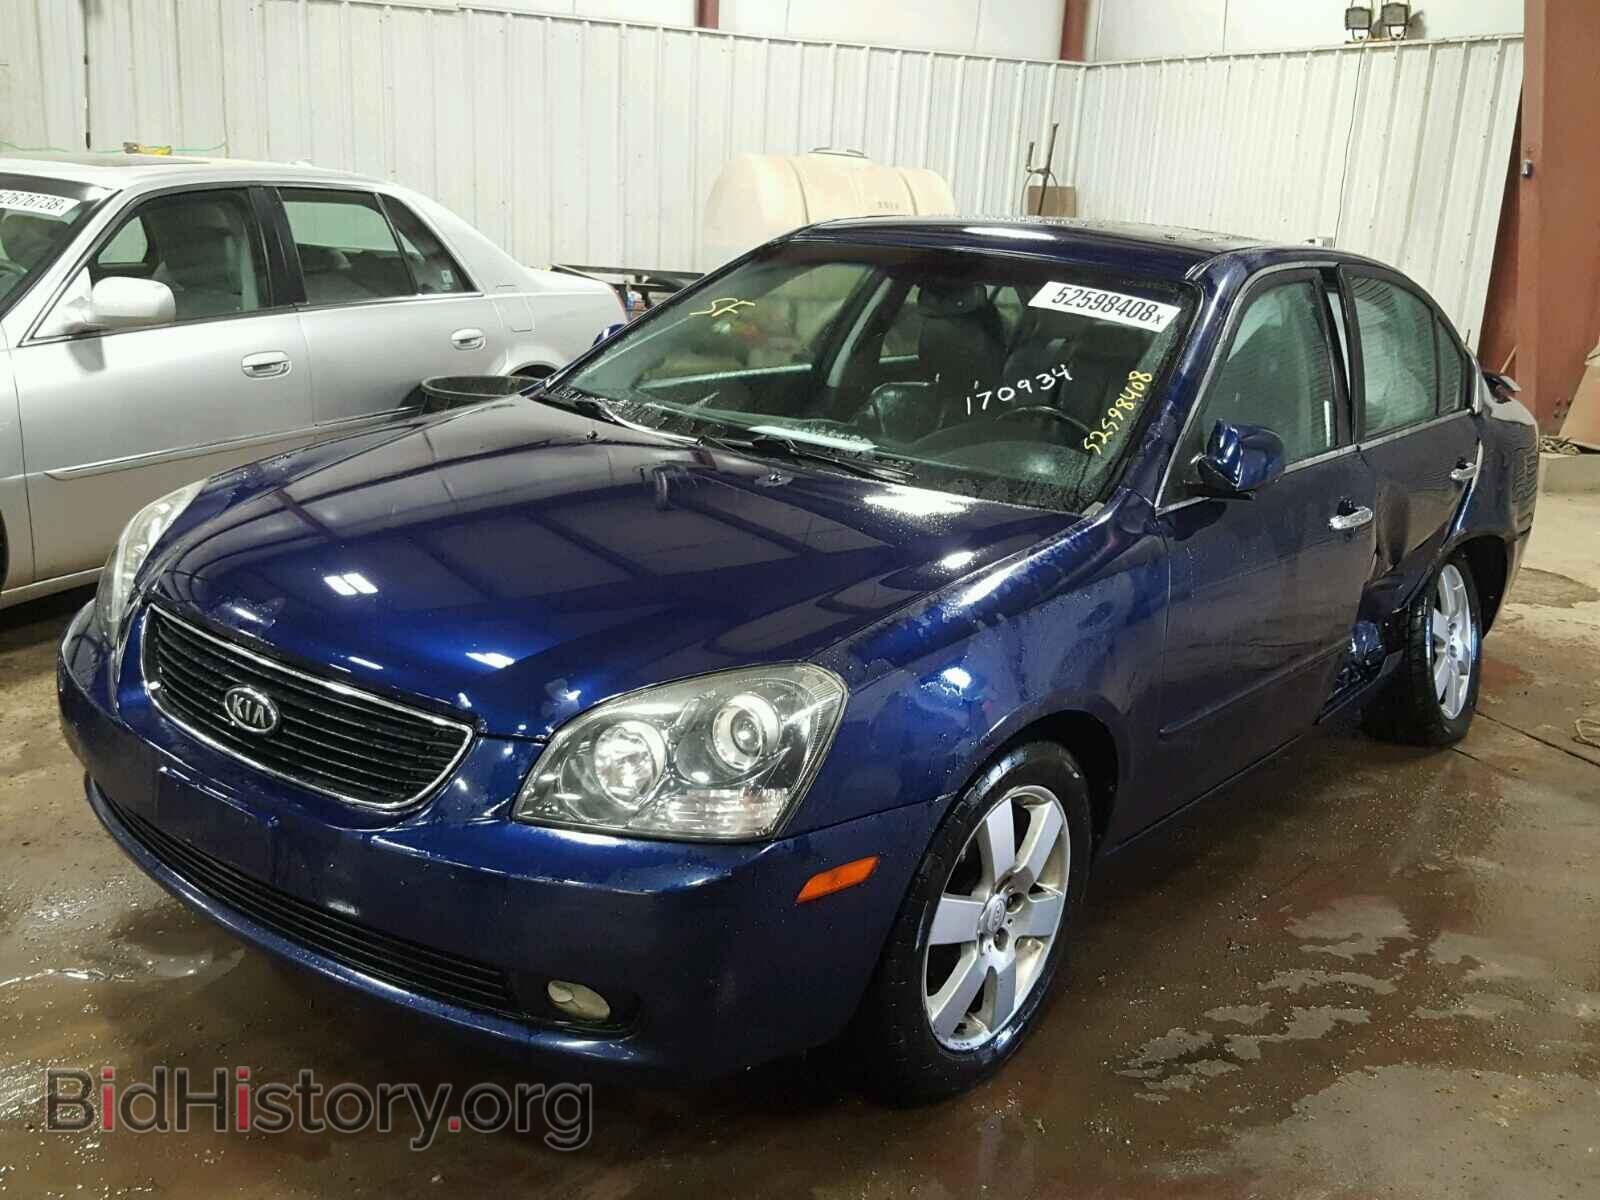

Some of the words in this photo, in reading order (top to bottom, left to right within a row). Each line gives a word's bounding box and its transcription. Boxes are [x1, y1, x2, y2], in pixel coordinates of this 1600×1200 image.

[966, 363, 1073, 416] 170934
[1083, 370, 1153, 455] 52598408
[233, 693, 266, 729] KIA
